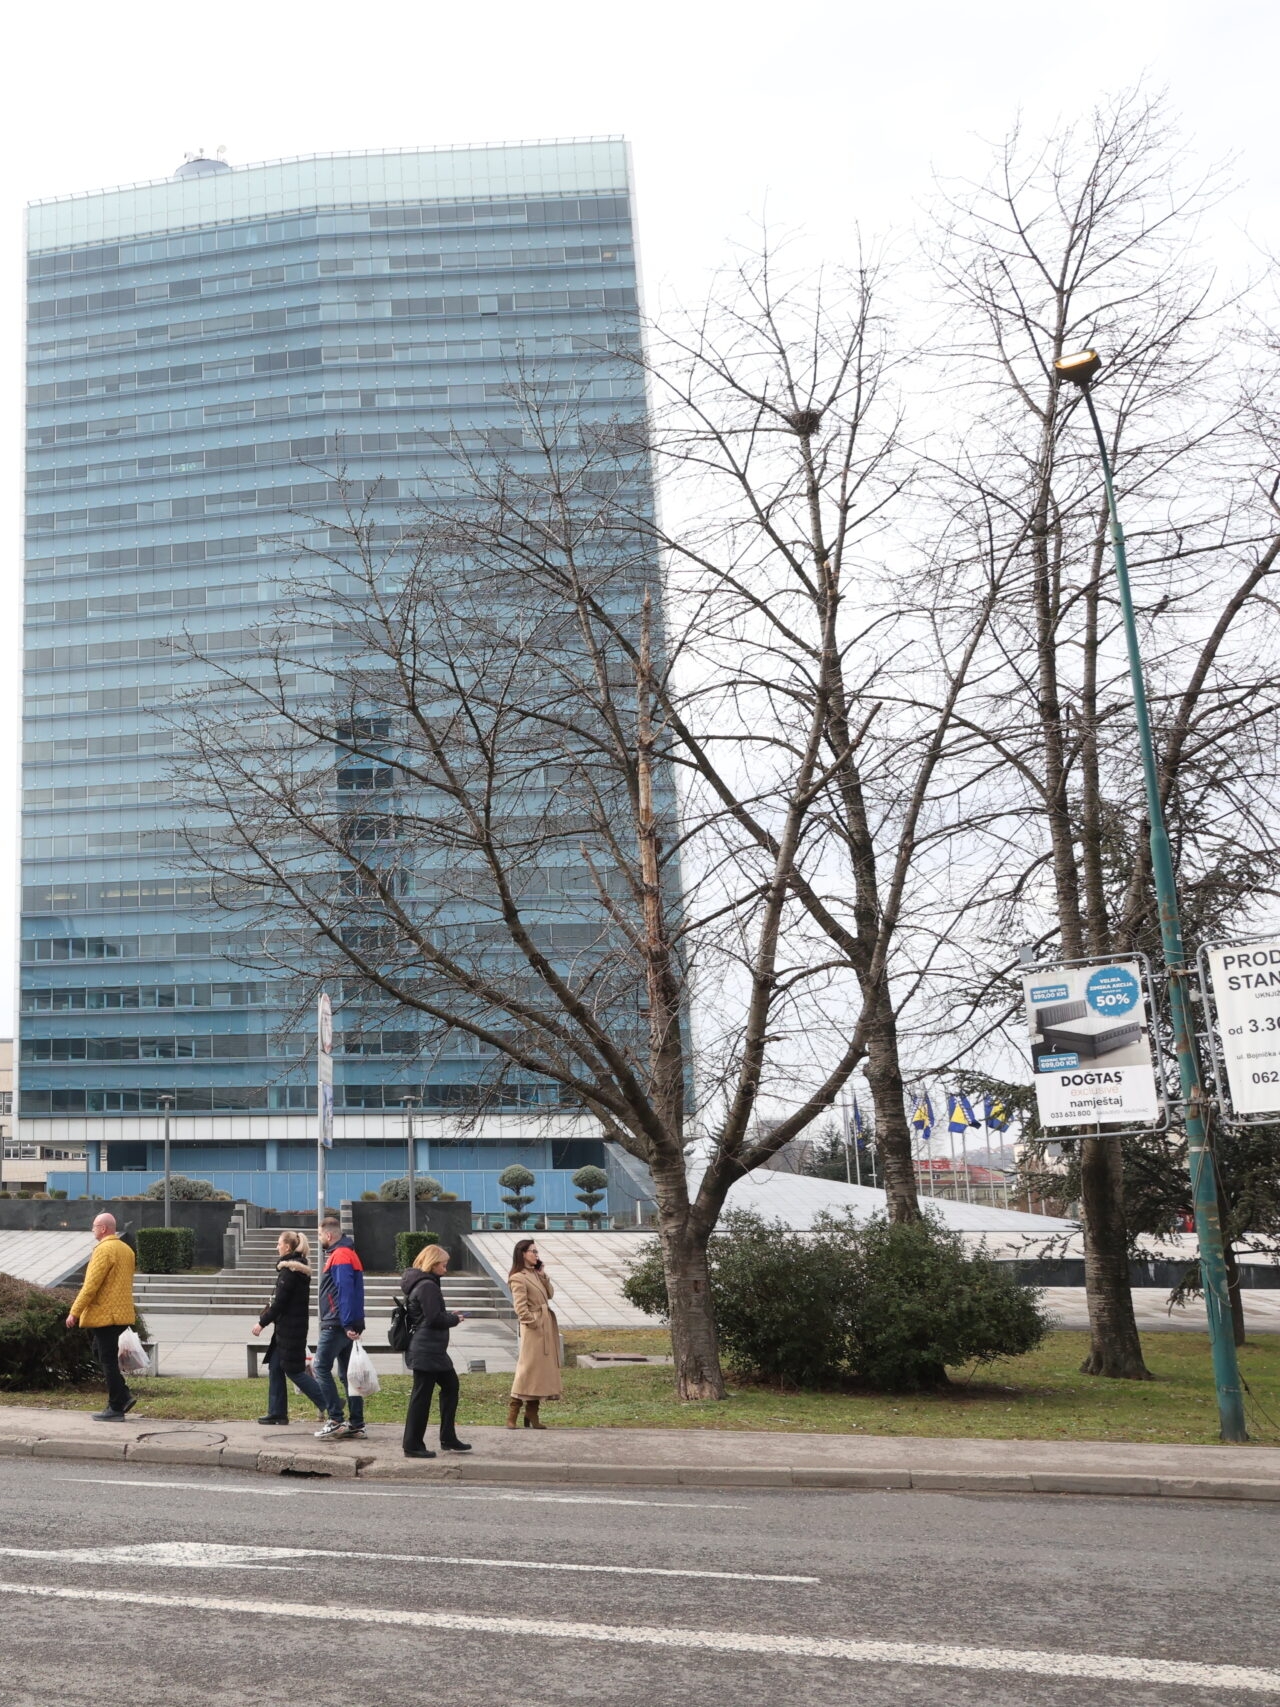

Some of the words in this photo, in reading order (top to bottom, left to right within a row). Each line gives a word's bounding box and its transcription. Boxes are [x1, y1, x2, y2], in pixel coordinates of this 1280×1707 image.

[1223, 949, 1280, 970] PROD
[1228, 970, 1280, 991] STAN
[1096, 993, 1130, 1007] 50%
[1228, 1025, 1243, 1035] od
[1252, 1071, 1279, 1084] 062
[1071, 1086, 1119, 1097] exclusive
[1070, 1096, 1123, 1109] namještaj
